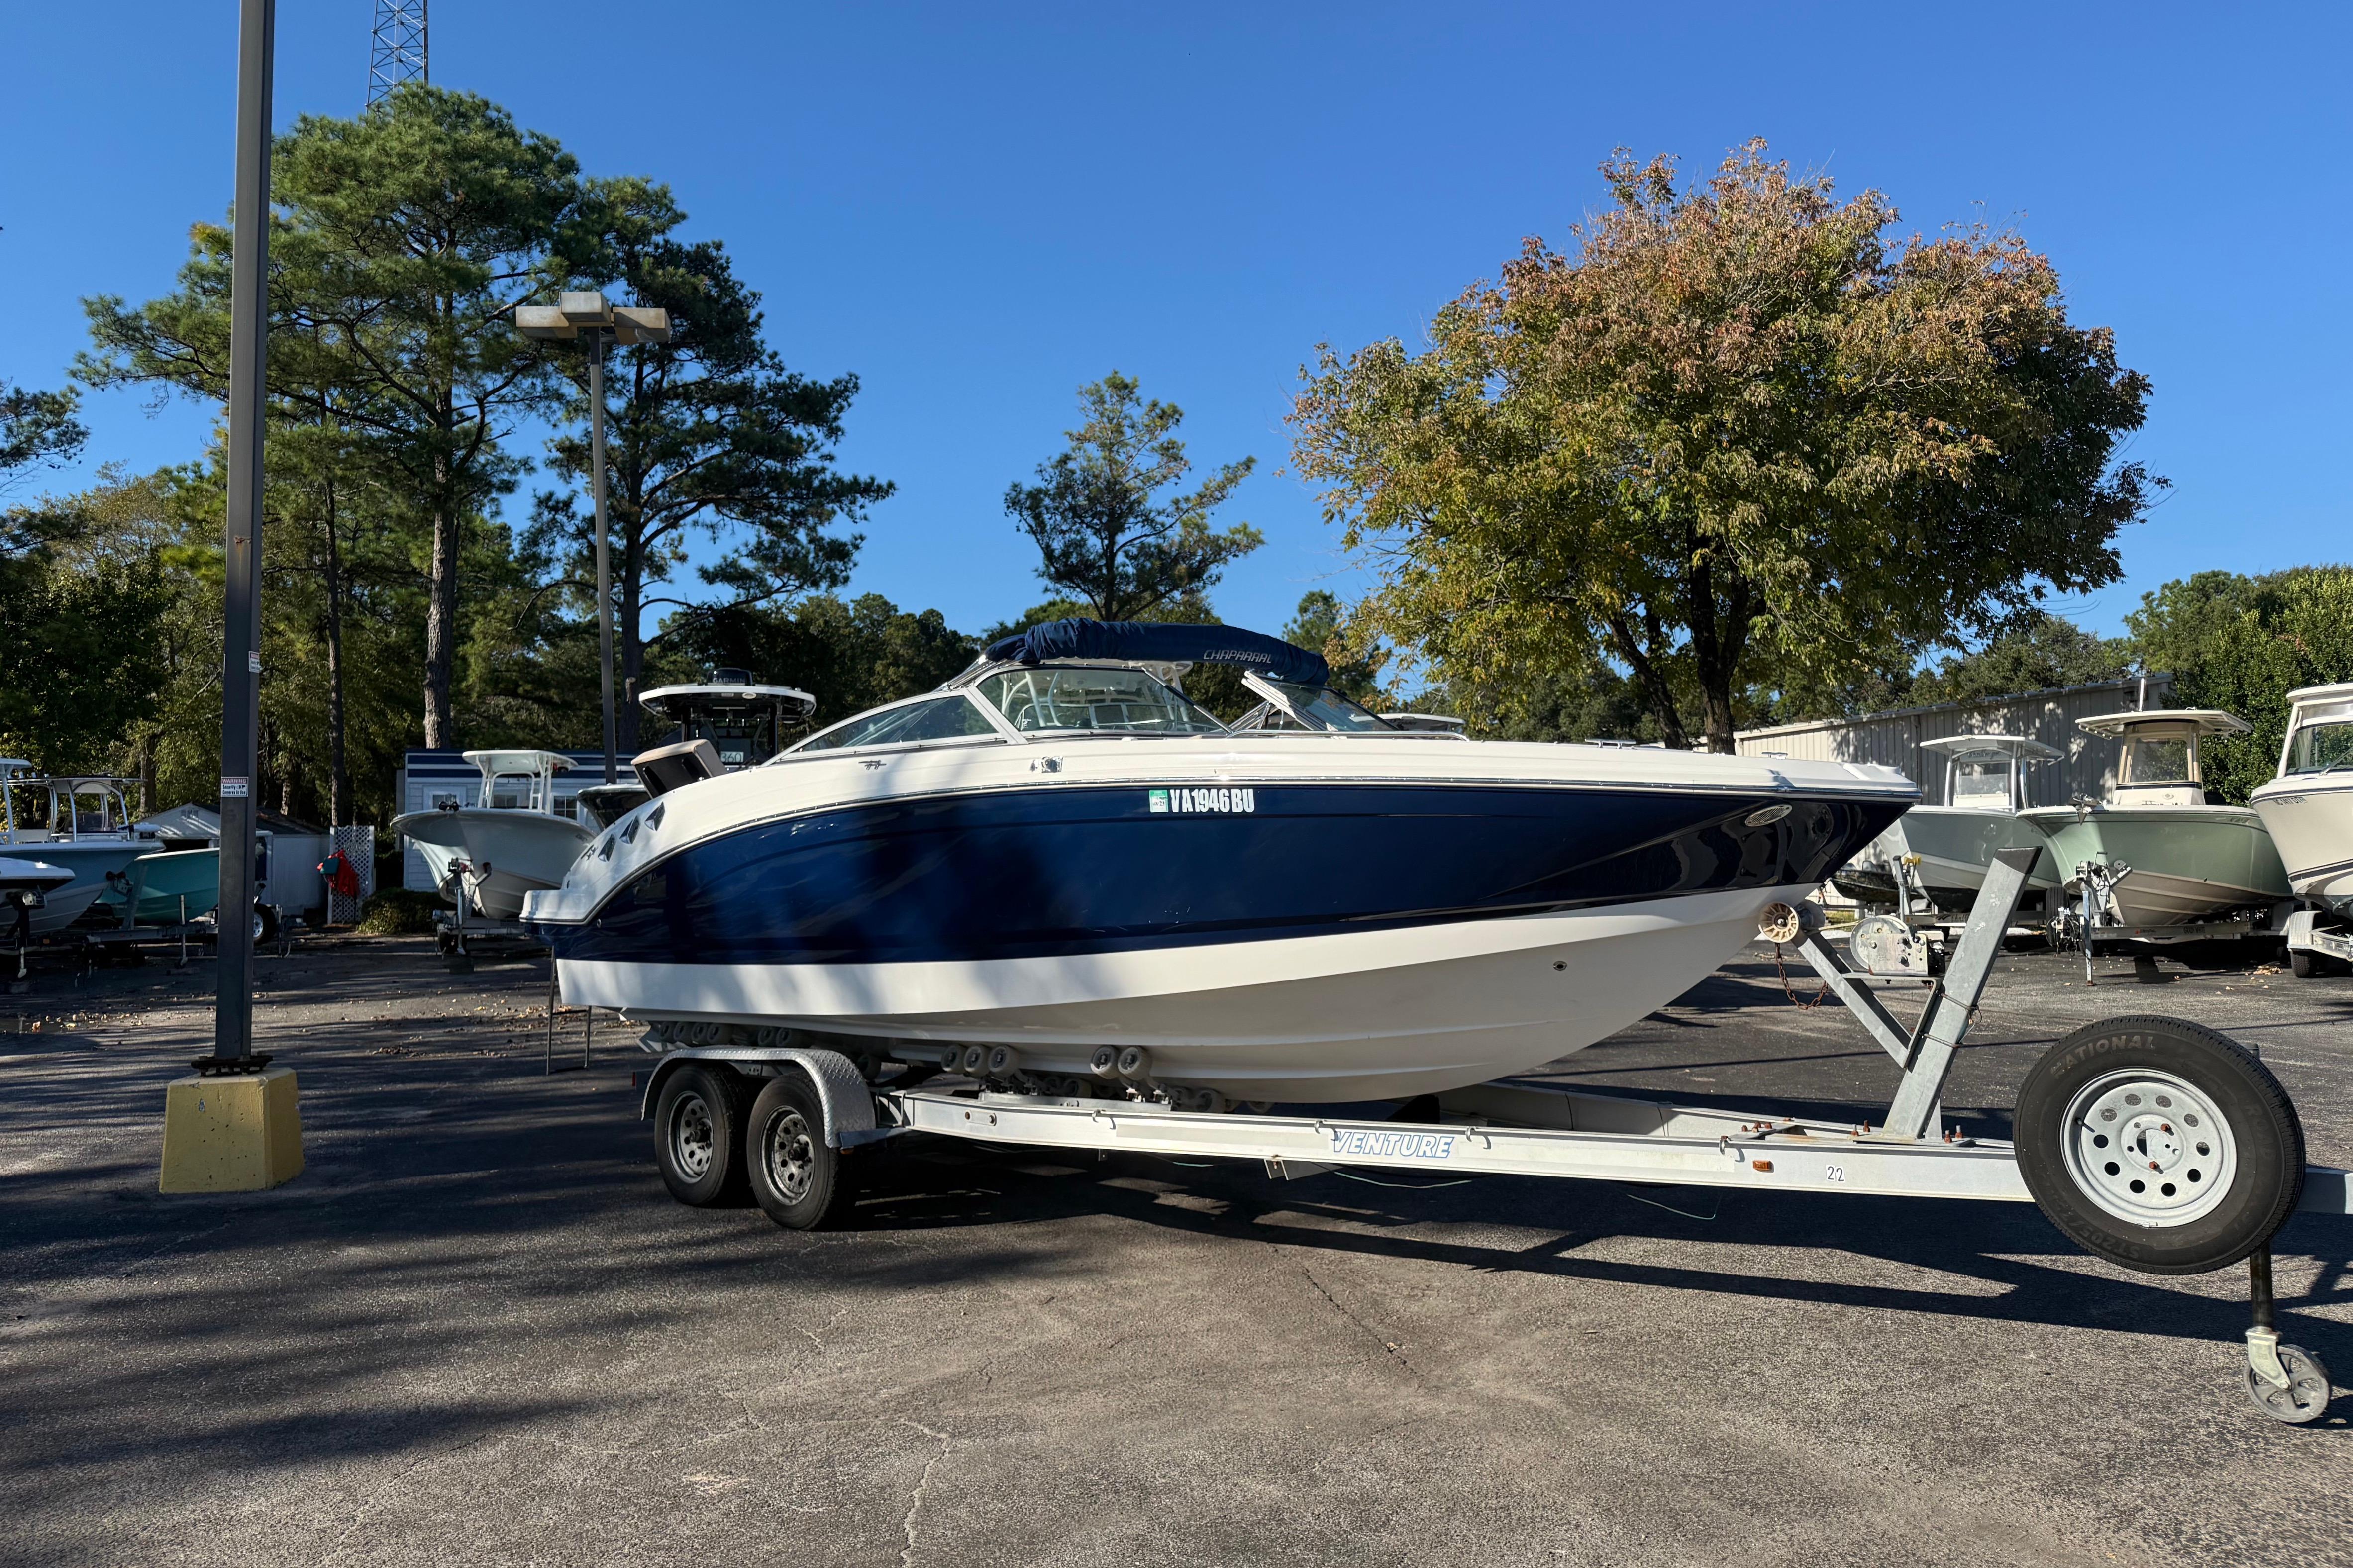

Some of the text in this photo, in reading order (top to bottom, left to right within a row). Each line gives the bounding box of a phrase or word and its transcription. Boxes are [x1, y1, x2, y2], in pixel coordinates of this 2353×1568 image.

[1203, 650, 1272, 664] CHAPARRAL
[721, 753, 742, 762] 360
[1334, 1131, 1455, 1158] VENTURE
[1827, 1166, 1844, 1182] 22
